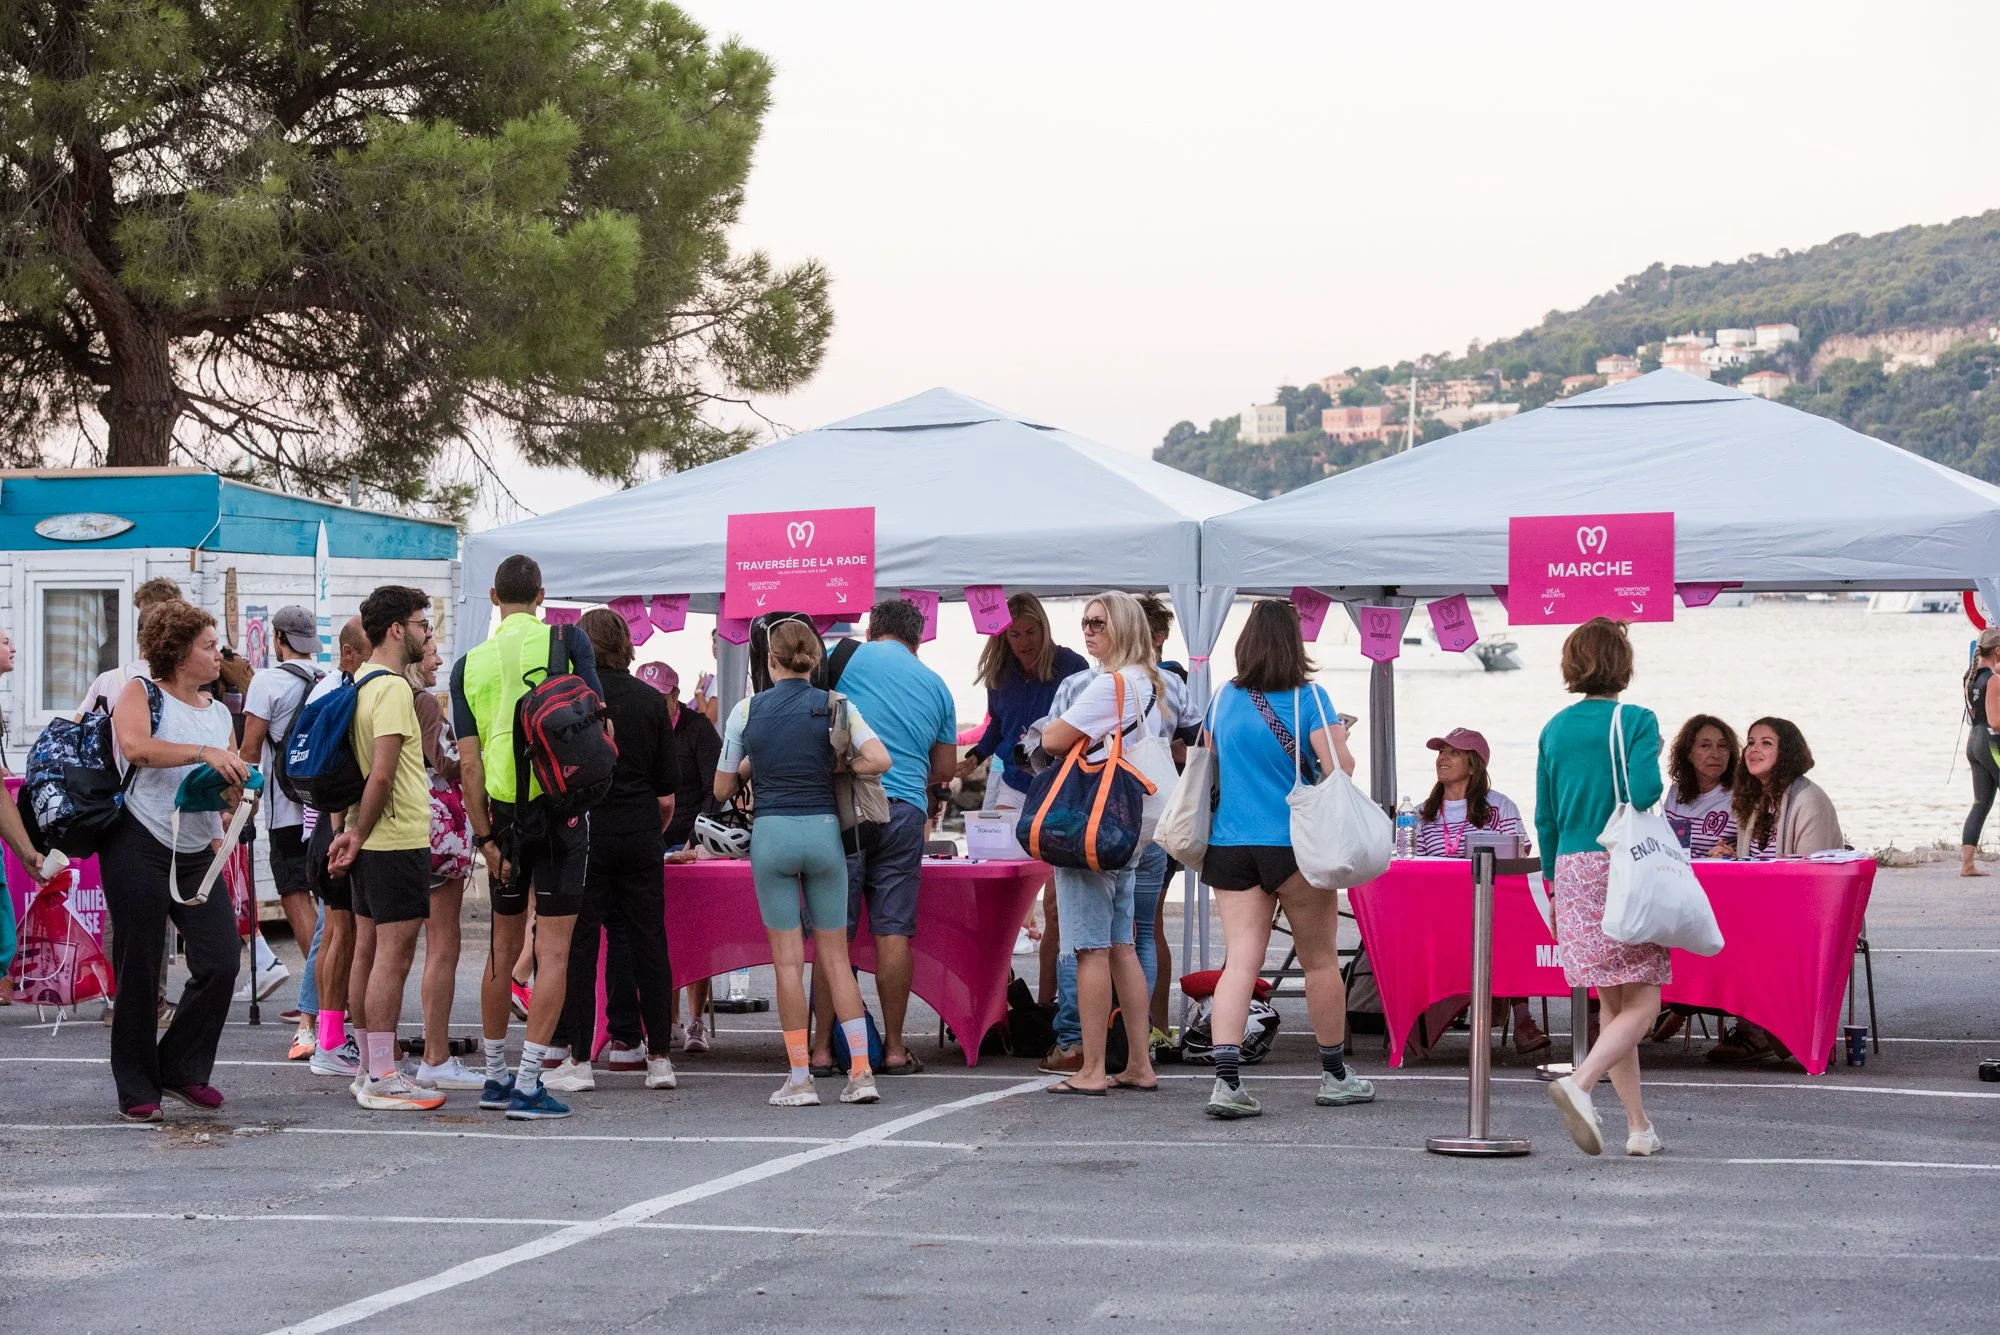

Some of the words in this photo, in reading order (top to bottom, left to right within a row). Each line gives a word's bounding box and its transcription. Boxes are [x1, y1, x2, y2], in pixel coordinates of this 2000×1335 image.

[736, 557, 799, 571] TRAVERSÉE
[802, 558, 817, 568] DE
[819, 557, 834, 567] LA
[837, 555, 867, 566] RADE
[1548, 561, 1632, 577] MARCHE
[1629, 836, 1661, 862] ENJOY
[1536, 944, 1563, 968] MA
